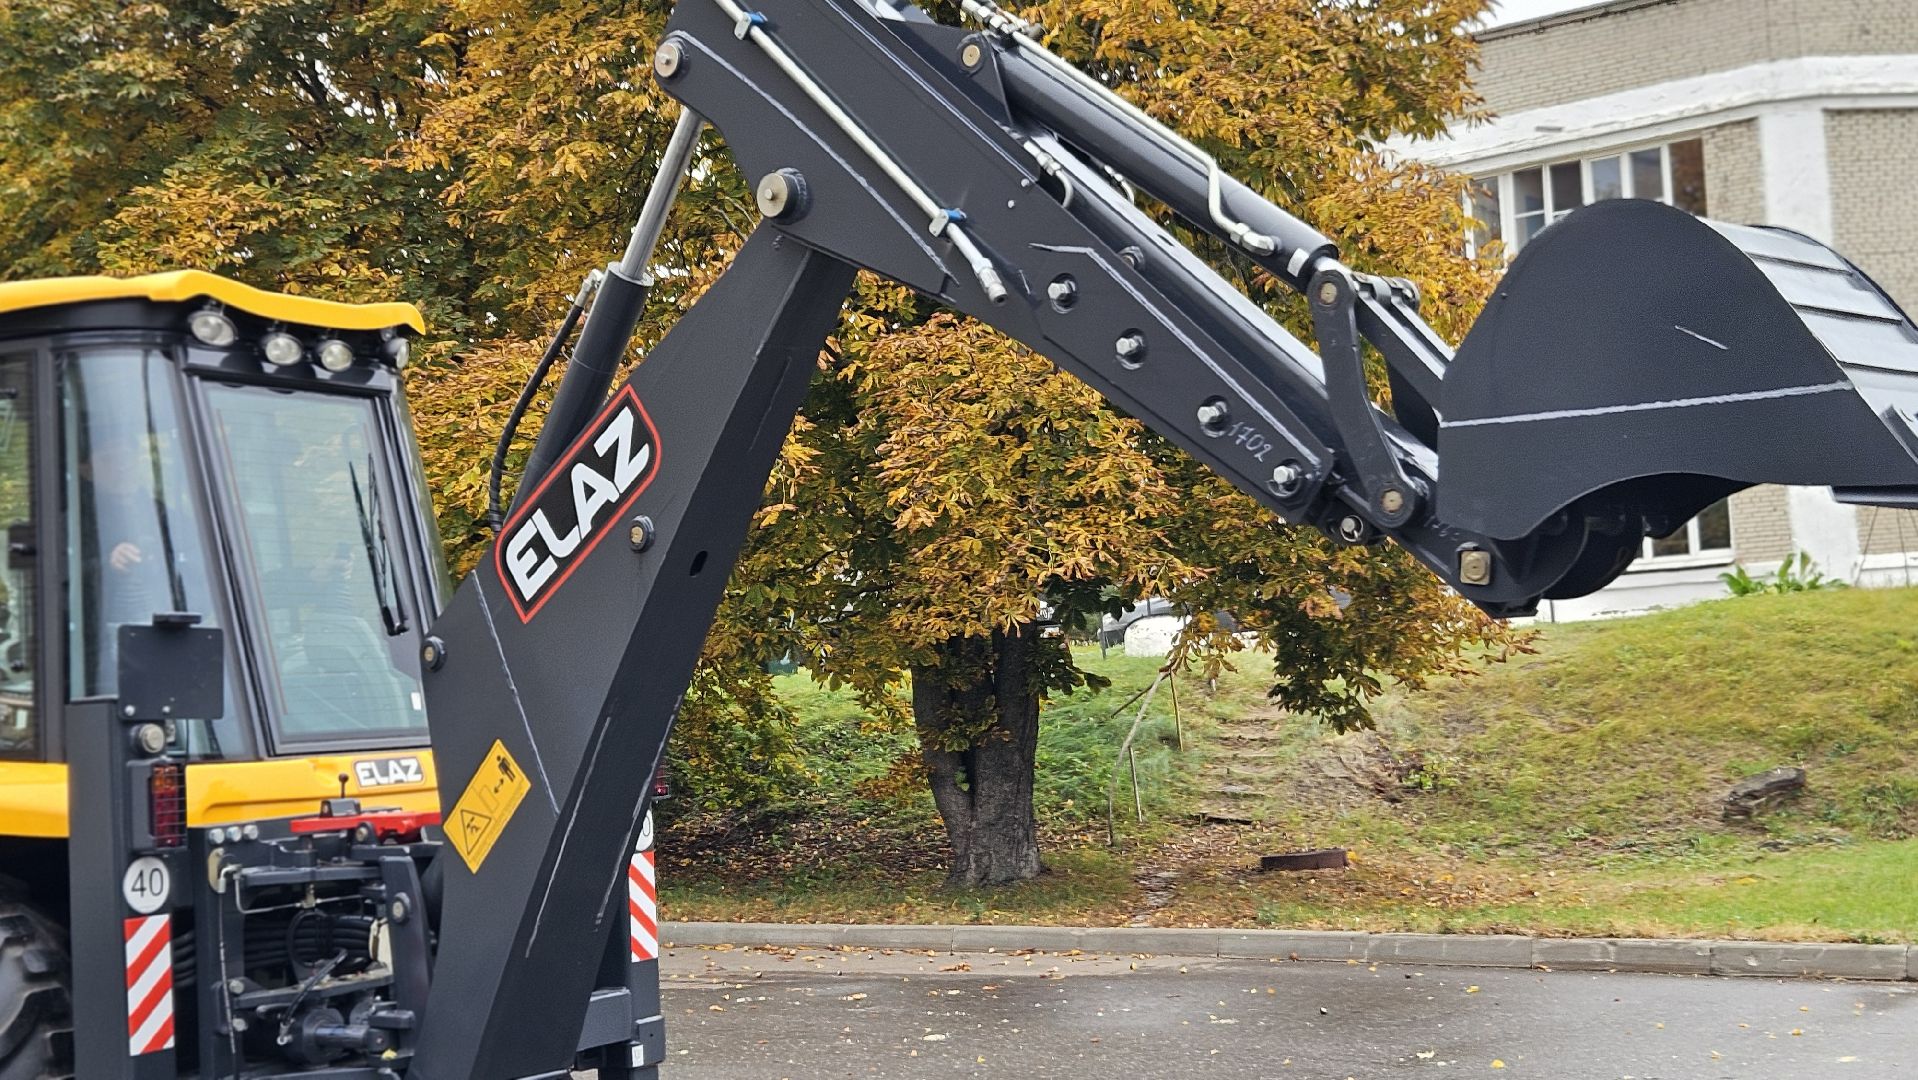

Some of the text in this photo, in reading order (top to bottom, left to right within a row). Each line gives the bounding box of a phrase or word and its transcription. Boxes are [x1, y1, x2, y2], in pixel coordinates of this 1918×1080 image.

[1228, 421, 1272, 463] 1702
[506, 406, 649, 601] ELAZ
[355, 758, 422, 786] ELAZ
[130, 867, 164, 898] 40
